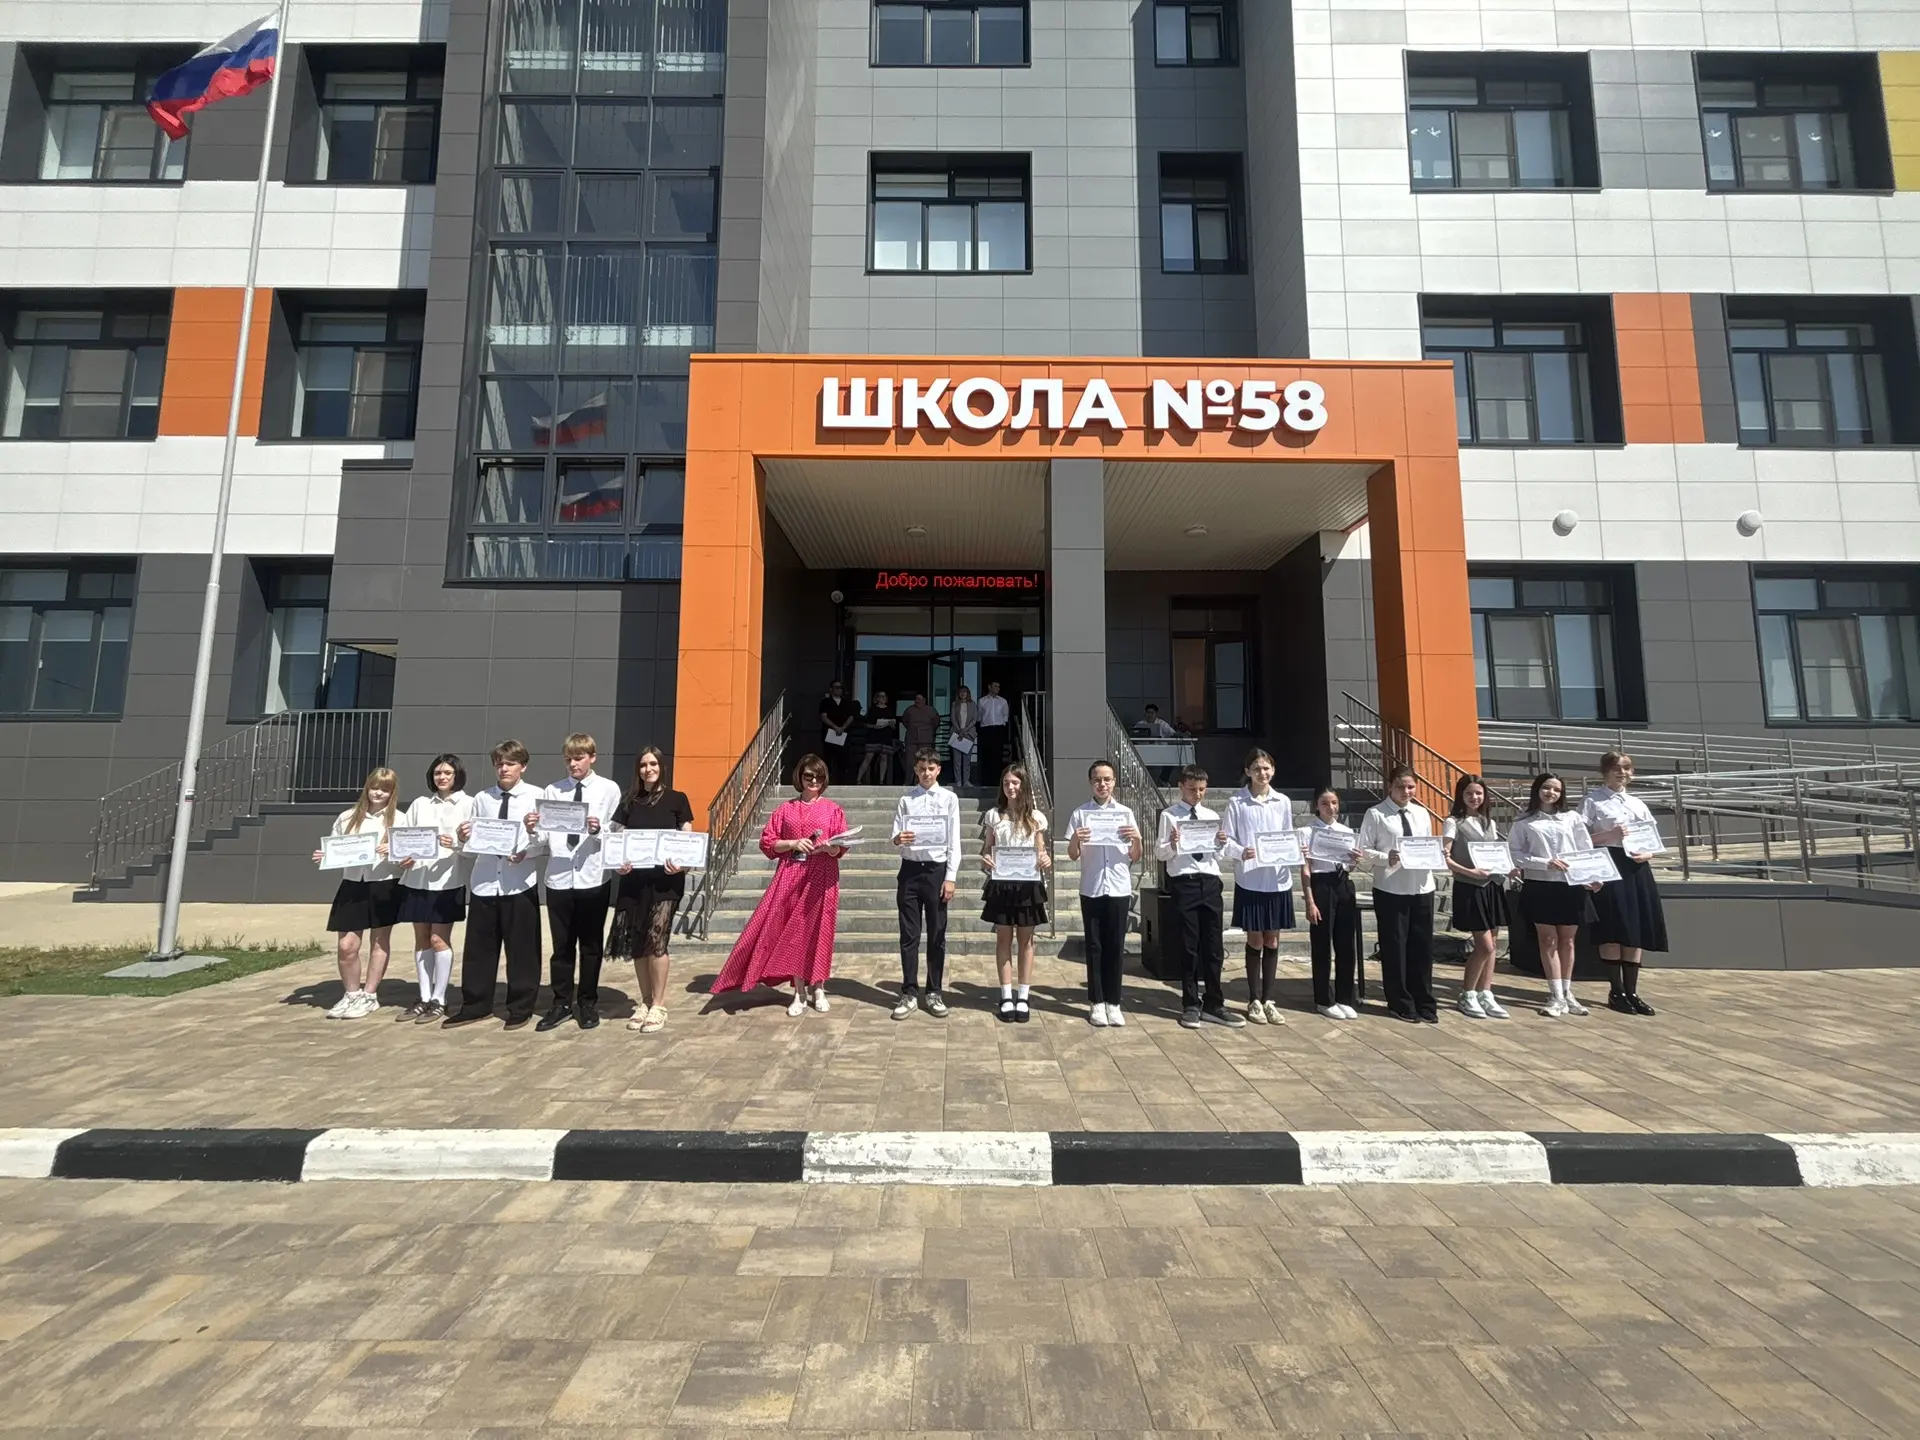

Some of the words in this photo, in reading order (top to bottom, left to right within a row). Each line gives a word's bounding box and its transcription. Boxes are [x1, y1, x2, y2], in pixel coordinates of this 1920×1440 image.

[822, 377, 1127, 430] ШКОЛА
[1153, 378, 1329, 432] №58
[875, 572, 928, 590] Добро
[934, 572, 1038, 589] пожаловать!
